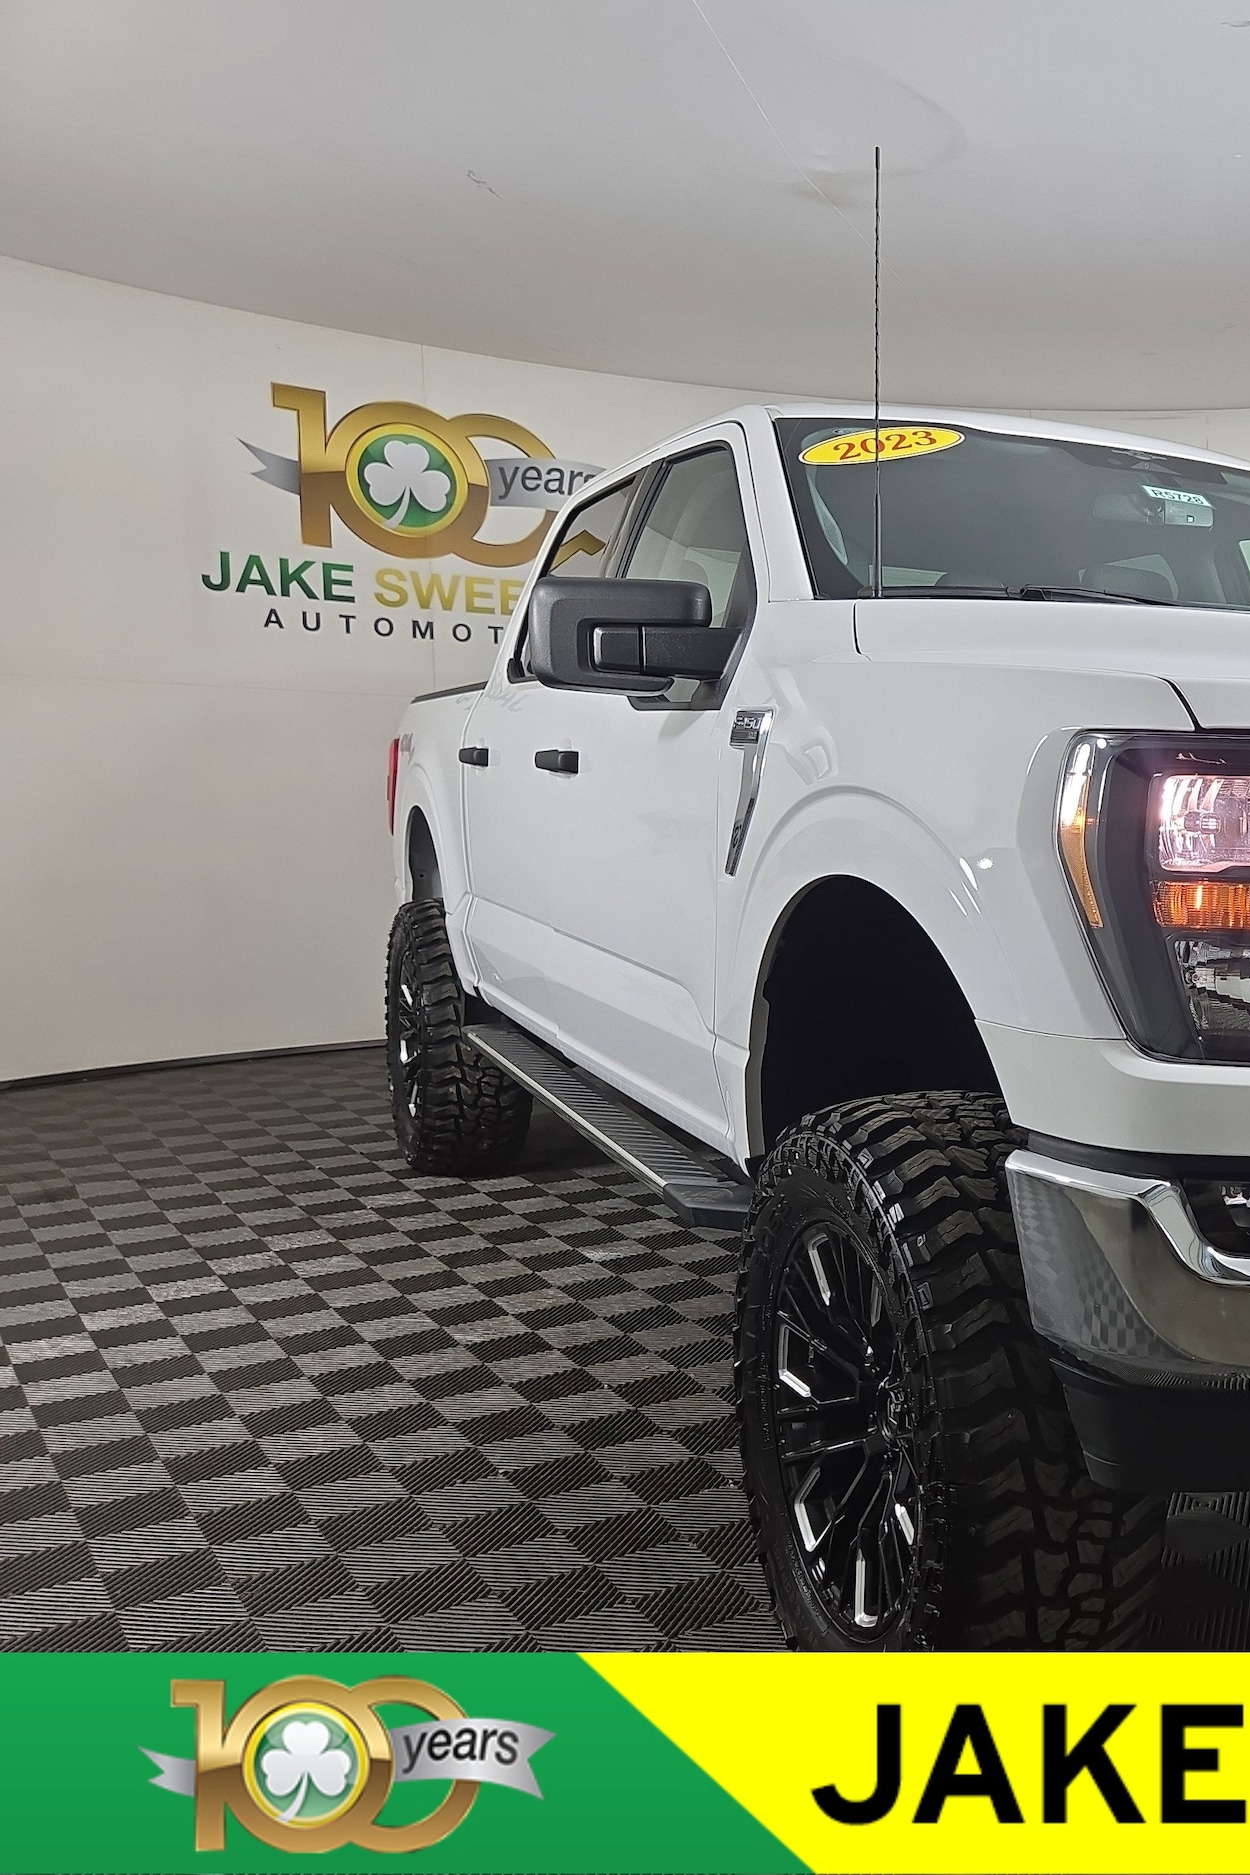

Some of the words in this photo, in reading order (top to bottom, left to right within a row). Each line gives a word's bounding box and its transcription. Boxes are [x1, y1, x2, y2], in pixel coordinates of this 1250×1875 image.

[833, 431, 937, 460] 2023
[201, 550, 356, 604] JAKE
[264, 608, 504, 645] AUTOMOT
